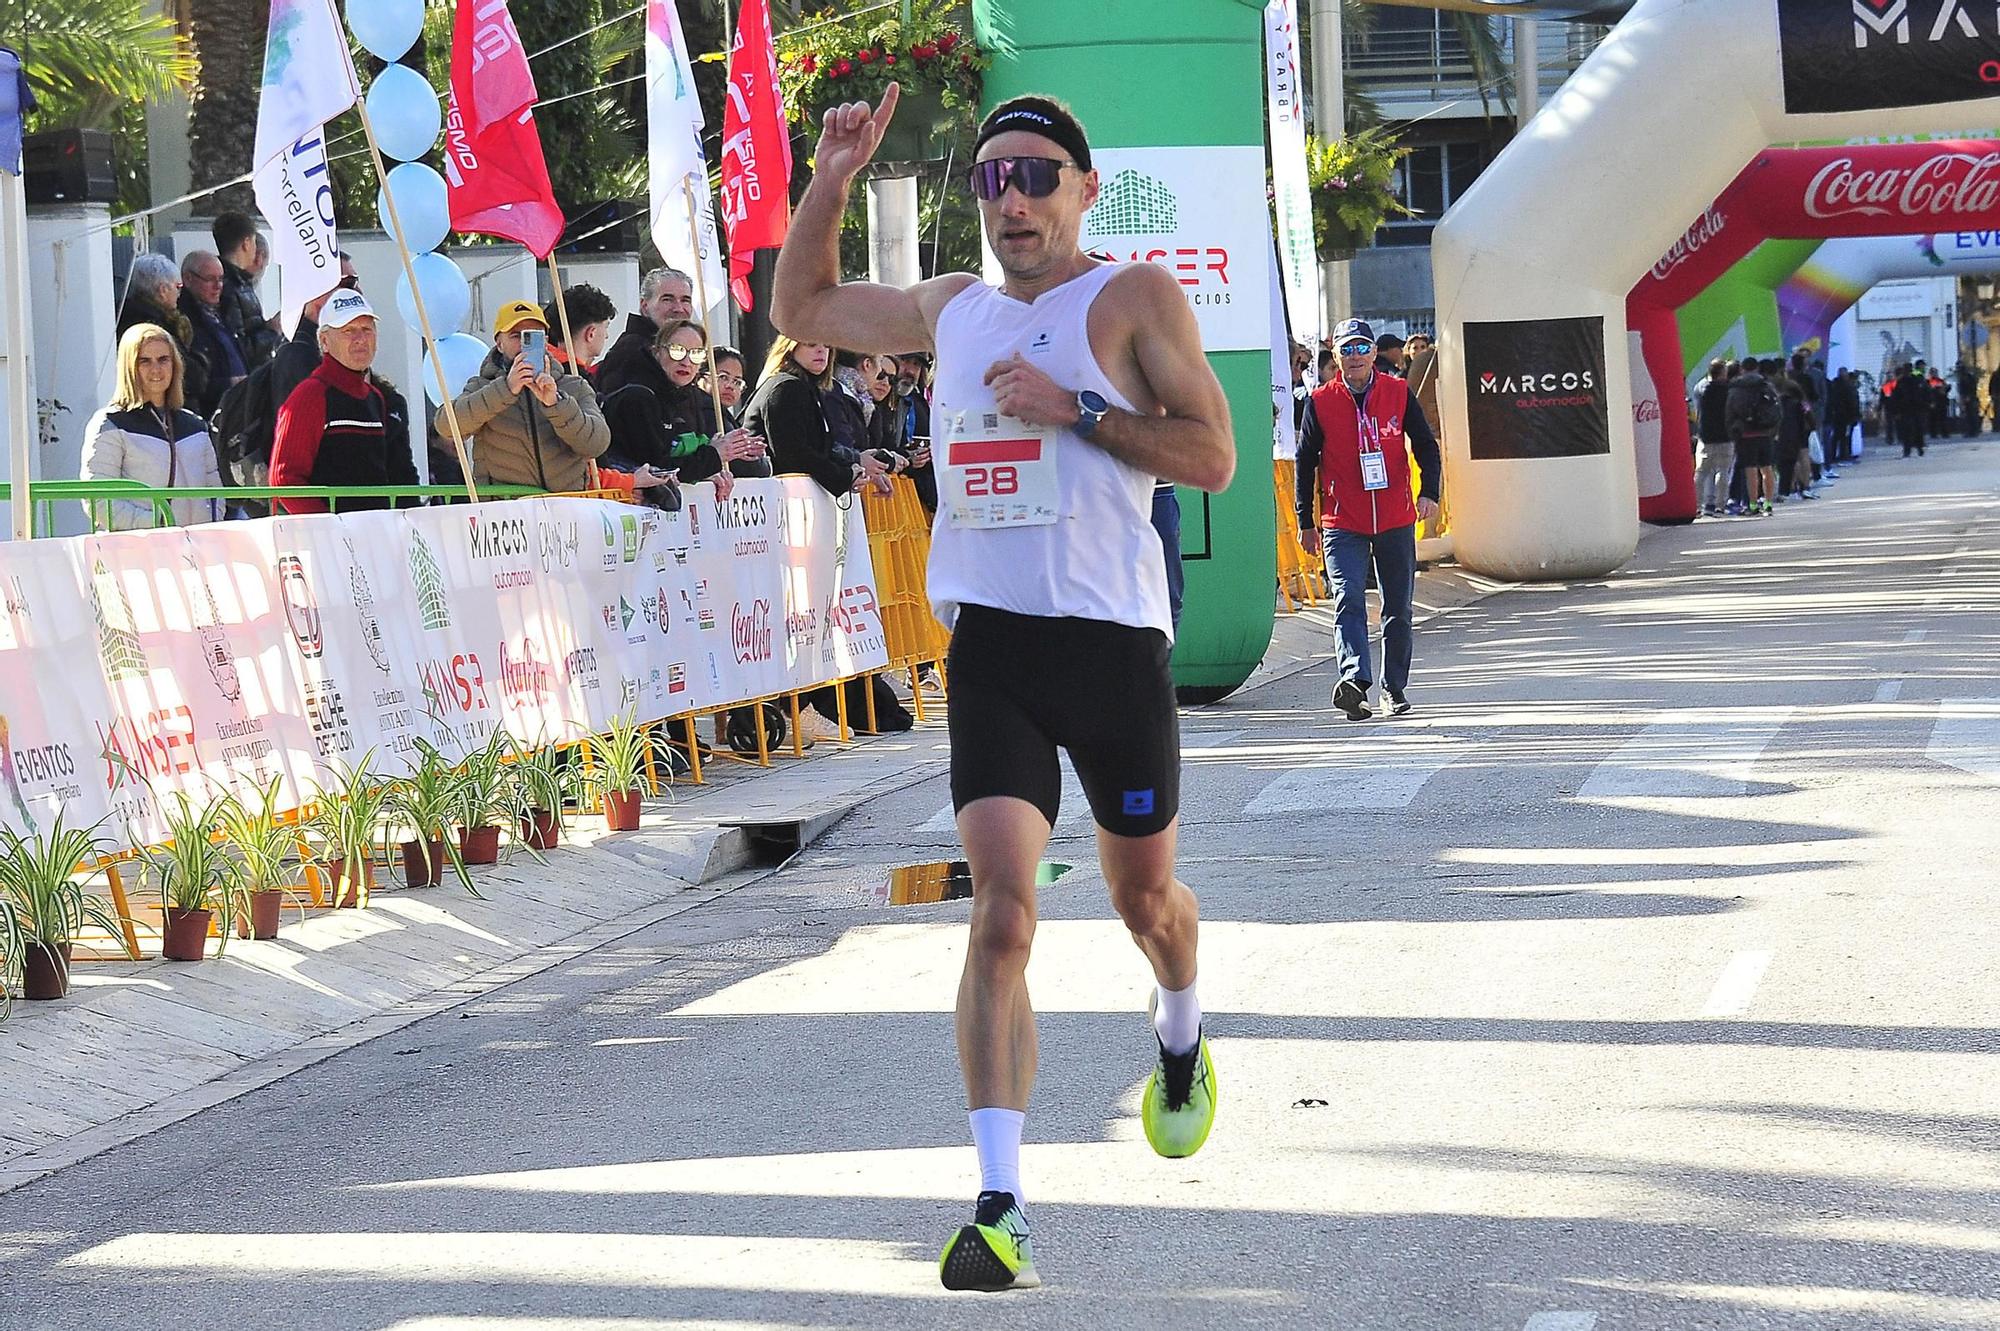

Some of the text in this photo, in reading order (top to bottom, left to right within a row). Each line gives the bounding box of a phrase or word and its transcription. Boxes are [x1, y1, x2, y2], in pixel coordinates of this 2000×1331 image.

[1852, 0, 2000, 48] MA
[1803, 152, 2000, 219] Coca-Cola
[1480, 370, 1593, 394] MARCOS
[1516, 394, 1594, 408] automoción
[965, 466, 1018, 496] 28
[715, 495, 767, 530] MARCOS
[468, 517, 528, 559] MARCOS
[14, 743, 75, 784] EVENTOS
